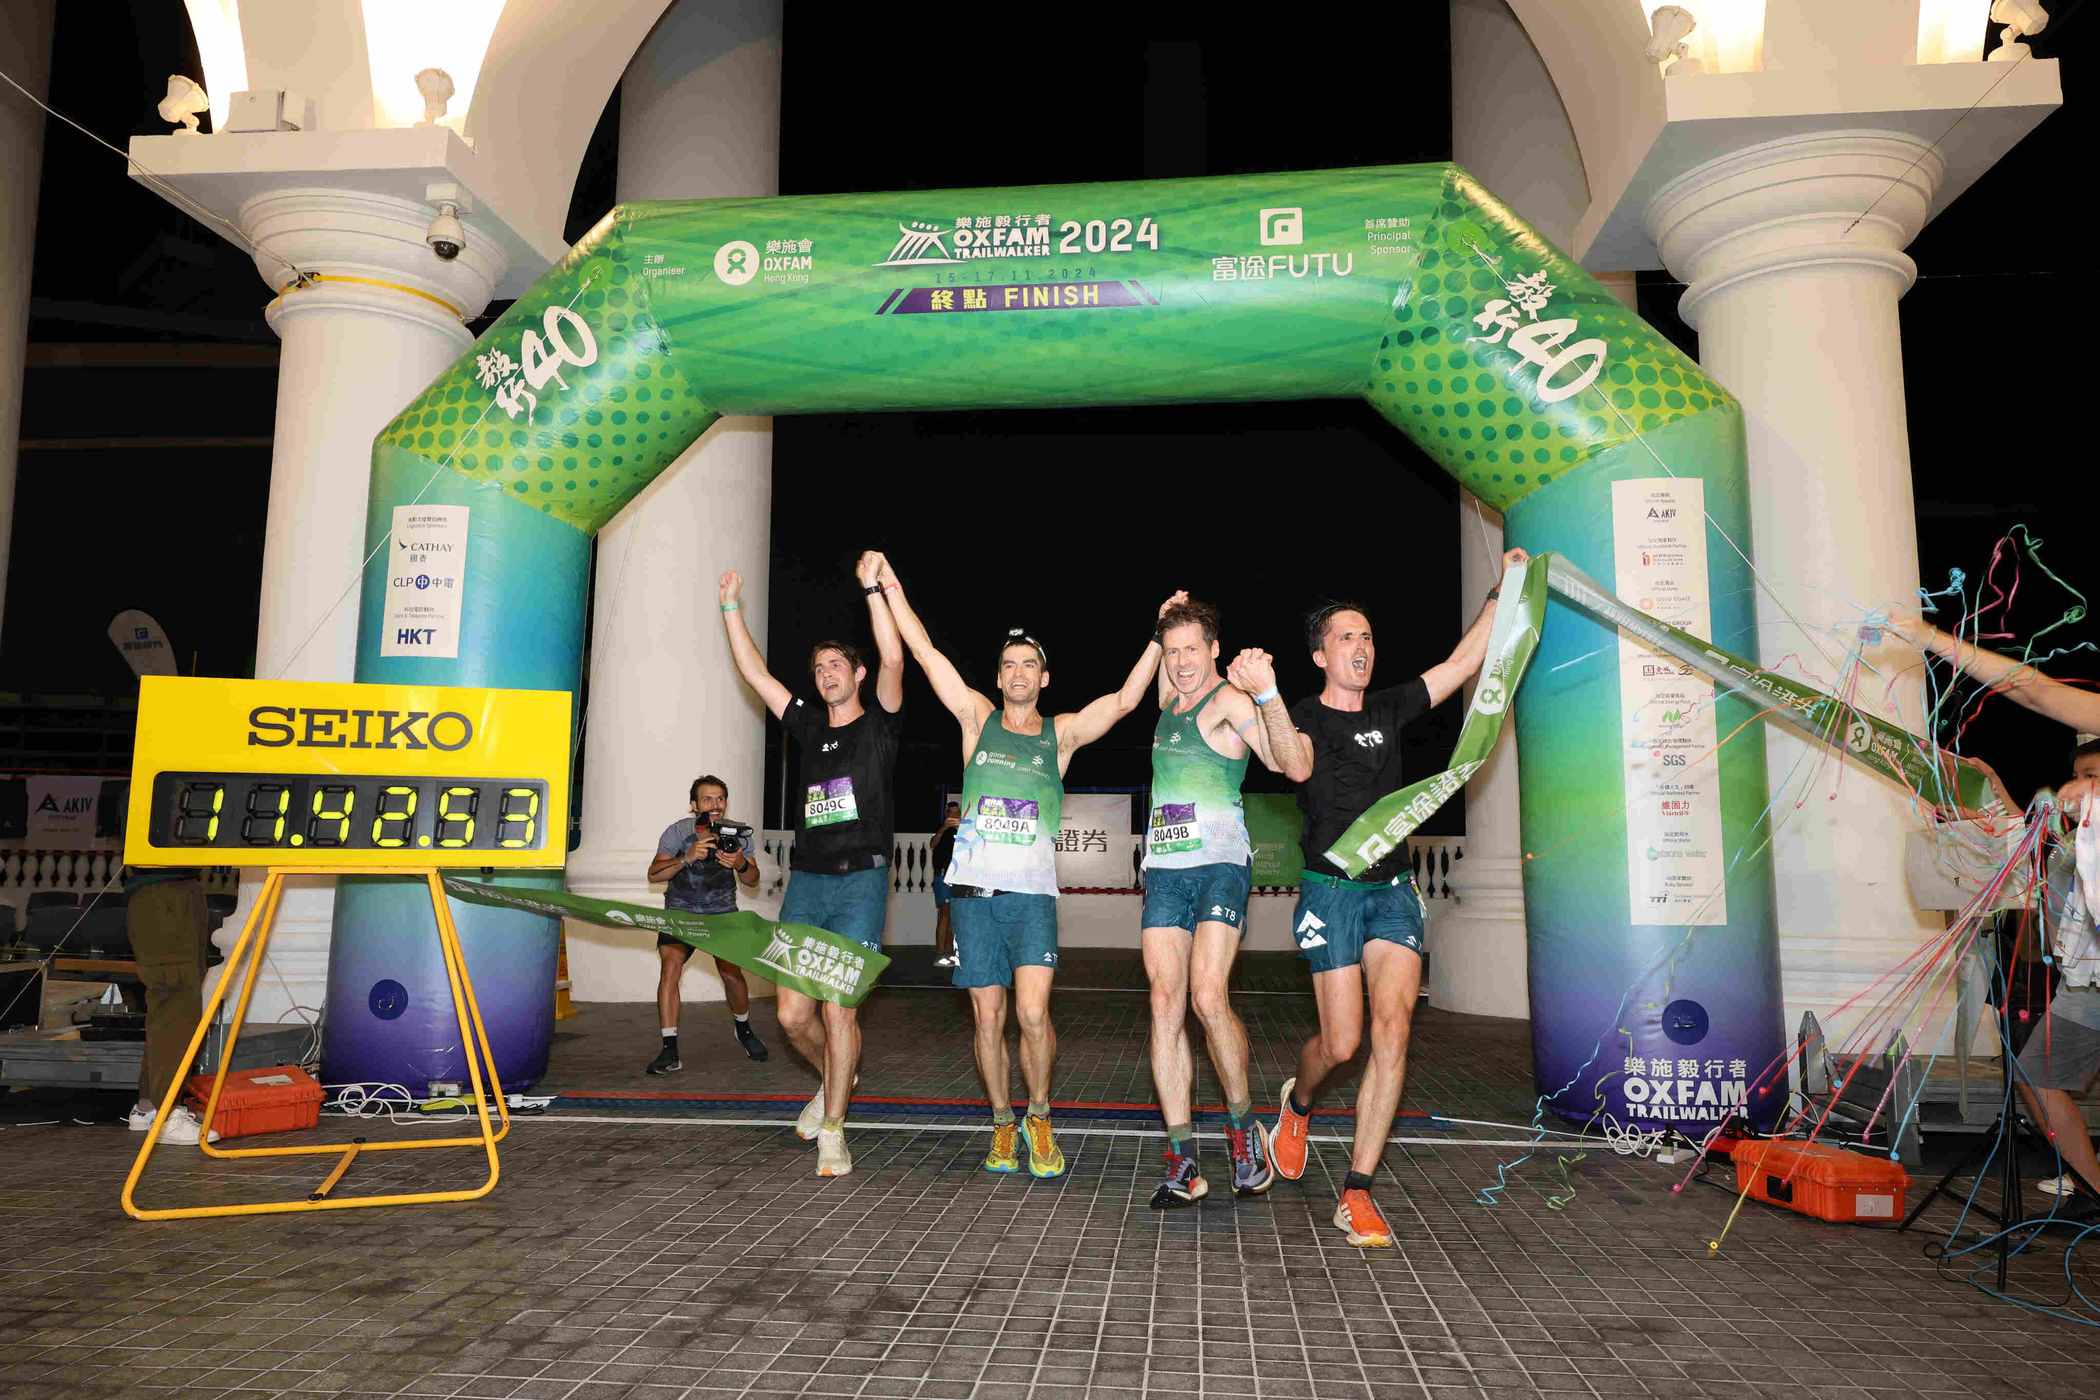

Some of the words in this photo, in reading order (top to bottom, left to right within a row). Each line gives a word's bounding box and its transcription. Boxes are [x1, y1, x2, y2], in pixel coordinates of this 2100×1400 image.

[956, 214, 1051, 228] 樂施毅行者
[953, 227, 1050, 247] OXFAM
[1059, 218, 1158, 254] 2024
[1367, 231, 1411, 242] Principal
[765, 238, 813, 254] 樂施會
[954, 245, 1050, 259] TRAILWALKER
[1370, 245, 1410, 255] Sponsor
[644, 254, 665, 264] 主辦
[764, 256, 812, 271] OXFAM
[643, 267, 685, 277] Organiser
[764, 274, 786, 284] Hong
[787, 273, 809, 283] Kong
[936, 267, 1096, 283] 15-17.11.2024
[931, 289, 987, 310] 終點
[1004, 285, 1099, 307] FINISH
[522, 305, 598, 390] 40
[1507, 318, 1607, 403] 40
[1661, 508, 1677, 518] AKIV
[411, 543, 454, 552] CATHAY
[393, 577, 414, 587] CLP
[432, 577, 454, 588] 中電
[397, 629, 437, 644] HKT
[247, 706, 473, 751] SEIKO
[987, 758, 1016, 769] running
[1663, 755, 1686, 766] SGS
[62, 797, 92, 813] AKIV
[810, 799, 847, 814] 8049C
[1661, 801, 1689, 809] 維固力
[985, 818, 1030, 832] 8049A
[1055, 829, 1107, 852] 證券
[1154, 826, 1189, 841] 8049B
[1224, 907, 1236, 921] T8
[802, 936, 865, 970] 樂施毅行者
[798, 949, 862, 987] OXFAM
[795, 965, 855, 996] TRAILWALKER
[1624, 1057, 1747, 1078] 樂施毅行者
[1623, 1077, 1748, 1105] OXFAM
[1626, 1104, 1749, 1120] TRAILWALKER
